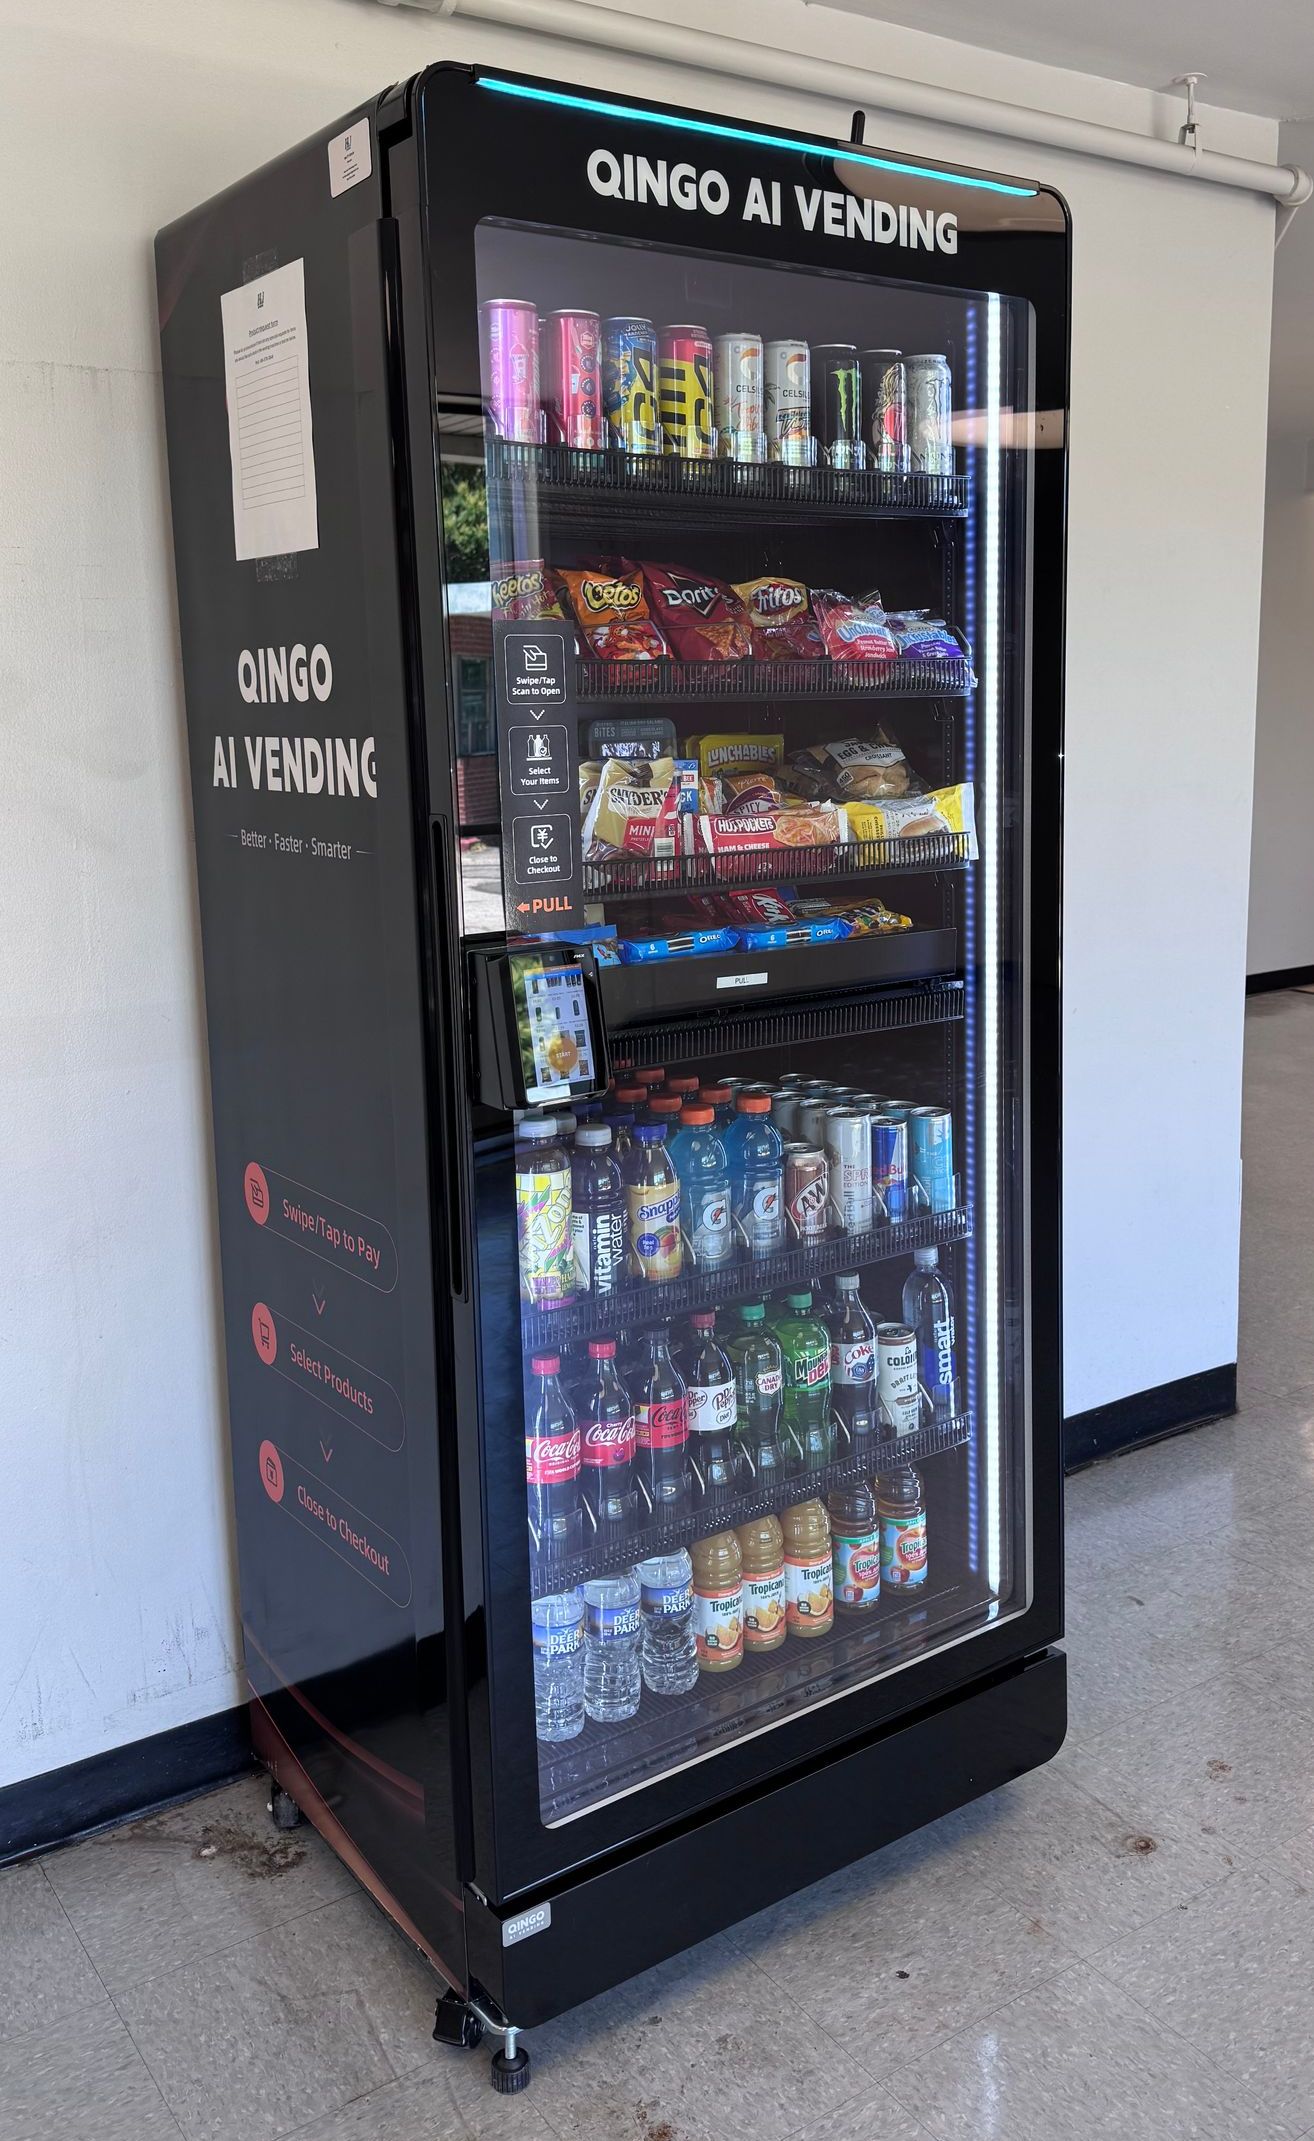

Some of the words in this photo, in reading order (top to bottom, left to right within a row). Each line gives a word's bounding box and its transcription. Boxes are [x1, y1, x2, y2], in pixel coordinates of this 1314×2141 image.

[587, 149, 730, 216] QINGO
[742, 176, 782, 226] AI
[794, 185, 958, 255] VENDING
[492, 572, 542, 608] heetos
[752, 585, 804, 613] Fritos
[237, 643, 333, 704] QINGO
[516, 677, 556, 686] Swipe/Tap
[531, 687, 540, 695] to
[541, 687, 561, 696] Open
[708, 744, 776, 768] LUNCHABLES
[837, 747, 858, 760] EGG
[858, 744, 869, 752] &
[864, 752, 893, 761] CROISSANT
[213, 736, 238, 788] AI
[244, 736, 378, 798] VENDING
[528, 767, 551, 775] Select
[520, 778, 538, 786] Your
[540, 777, 560, 785] Items
[839, 771, 852, 784] 450
[734, 818, 774, 831] POCKETS
[241, 829, 267, 849] Better
[274, 833, 303, 853] Faster
[311, 838, 352, 860] Smarter
[718, 845, 736, 853] HAM
[744, 842, 770, 850] CHEESE
[529, 856, 549, 864] Close
[527, 865, 561, 875] Checkout
[532, 896, 573, 914] PULL
[650, 943, 655, 951] 6
[556, 1051, 571, 1059] START
[843, 1170, 868, 1181] SPR
[639, 1192, 681, 1221] Snapp
[283, 1198, 340, 1249] Swipe/Tap
[343, 1229, 355, 1253] to
[358, 1236, 381, 1270] Pay
[611, 1213, 622, 1267] water
[593, 1214, 612, 1294] vitamin
[844, 1345, 874, 1364] Coke
[934, 1320, 952, 1385] smart
[290, 1343, 322, 1381] Select
[324, 1365, 374, 1415] Products
[891, 1374, 909, 1388] DRAFT
[764, 1383, 778, 1391] DRY
[719, 1411, 730, 1422] Diet
[297, 1485, 324, 1521] Close
[326, 1507, 337, 1531] to
[339, 1518, 390, 1576] Checkout
[663, 1590, 690, 1606] DEER
[663, 1600, 691, 1614] PARK
[613, 1608, 640, 1626] DEER
[613, 1621, 640, 1636] PARK
[550, 1629, 579, 1644] DEER
[550, 1641, 580, 1655] PARK
[508, 1910, 545, 1934] QINGO
